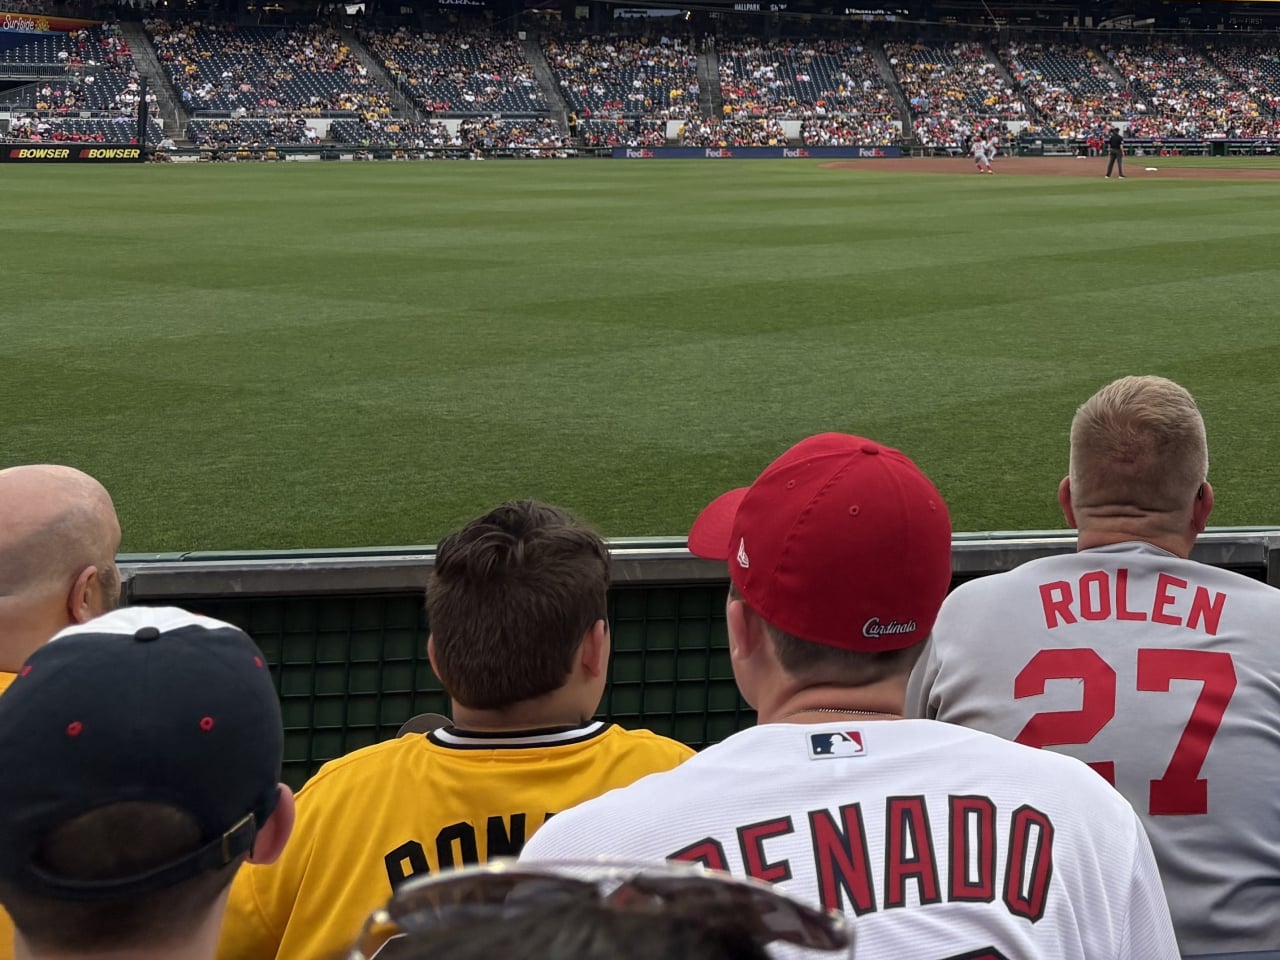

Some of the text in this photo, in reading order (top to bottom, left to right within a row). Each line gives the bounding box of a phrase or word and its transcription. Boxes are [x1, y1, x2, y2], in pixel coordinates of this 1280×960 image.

[18, 149, 70, 159] BOWSER
[88, 149, 140, 159] BOWSER
[626, 148, 654, 158] FedEx
[705, 148, 732, 158] FedEx
[783, 148, 809, 158] FedEx
[859, 147, 886, 157] FedEx
[1038, 568, 1227, 636] ROLEN
[863, 617, 916, 638] Cardinals
[1014, 647, 1237, 815] 27
